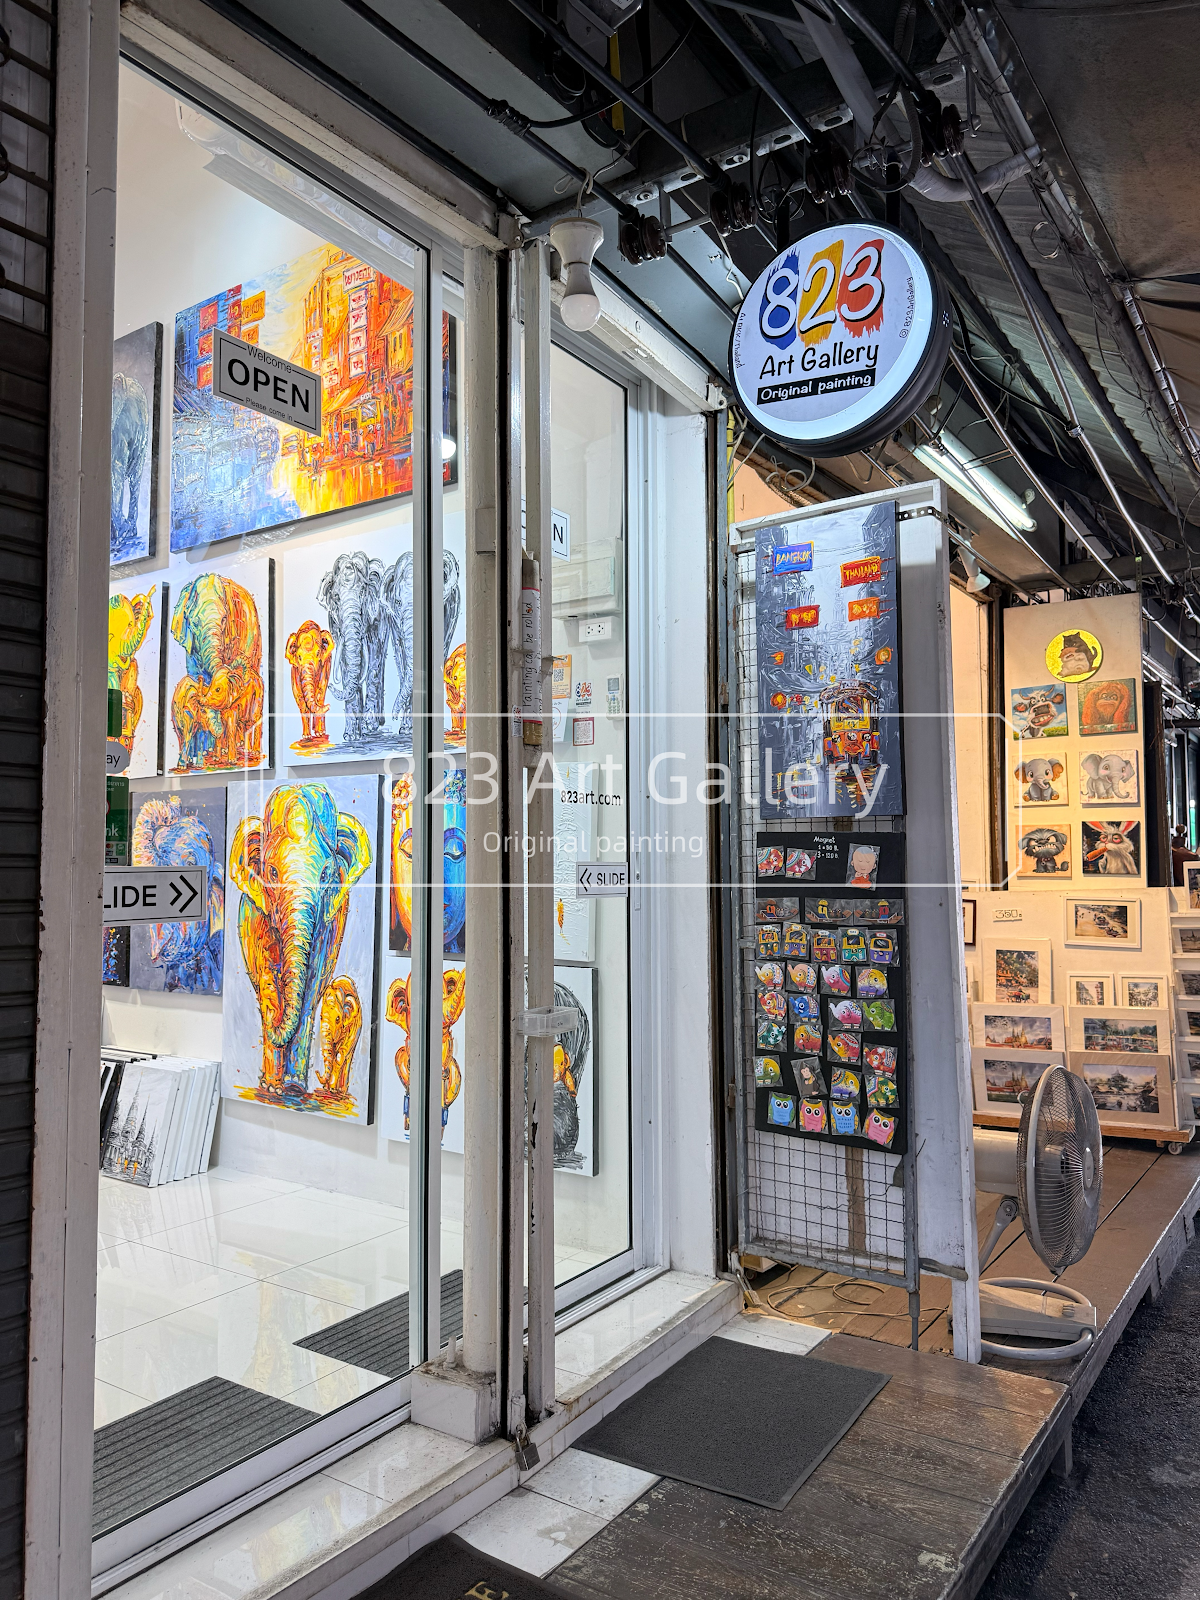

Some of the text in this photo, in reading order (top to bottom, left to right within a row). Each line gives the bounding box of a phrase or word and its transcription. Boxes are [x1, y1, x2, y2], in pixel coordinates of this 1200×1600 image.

[760, 247, 884, 339] 823
[247, 345, 292, 374] Welcome
[760, 341, 880, 380] Art Gallery
[227, 358, 310, 414] OPEN
[760, 374, 872, 401] Original painting
[245, 397, 267, 411] Please
[269, 407, 286, 419] come
[560, 790, 623, 806] 823art.com
[813, 836, 835, 844] Magnet
[596, 872, 626, 887] SLIDE
[104, 884, 158, 909] IDE
